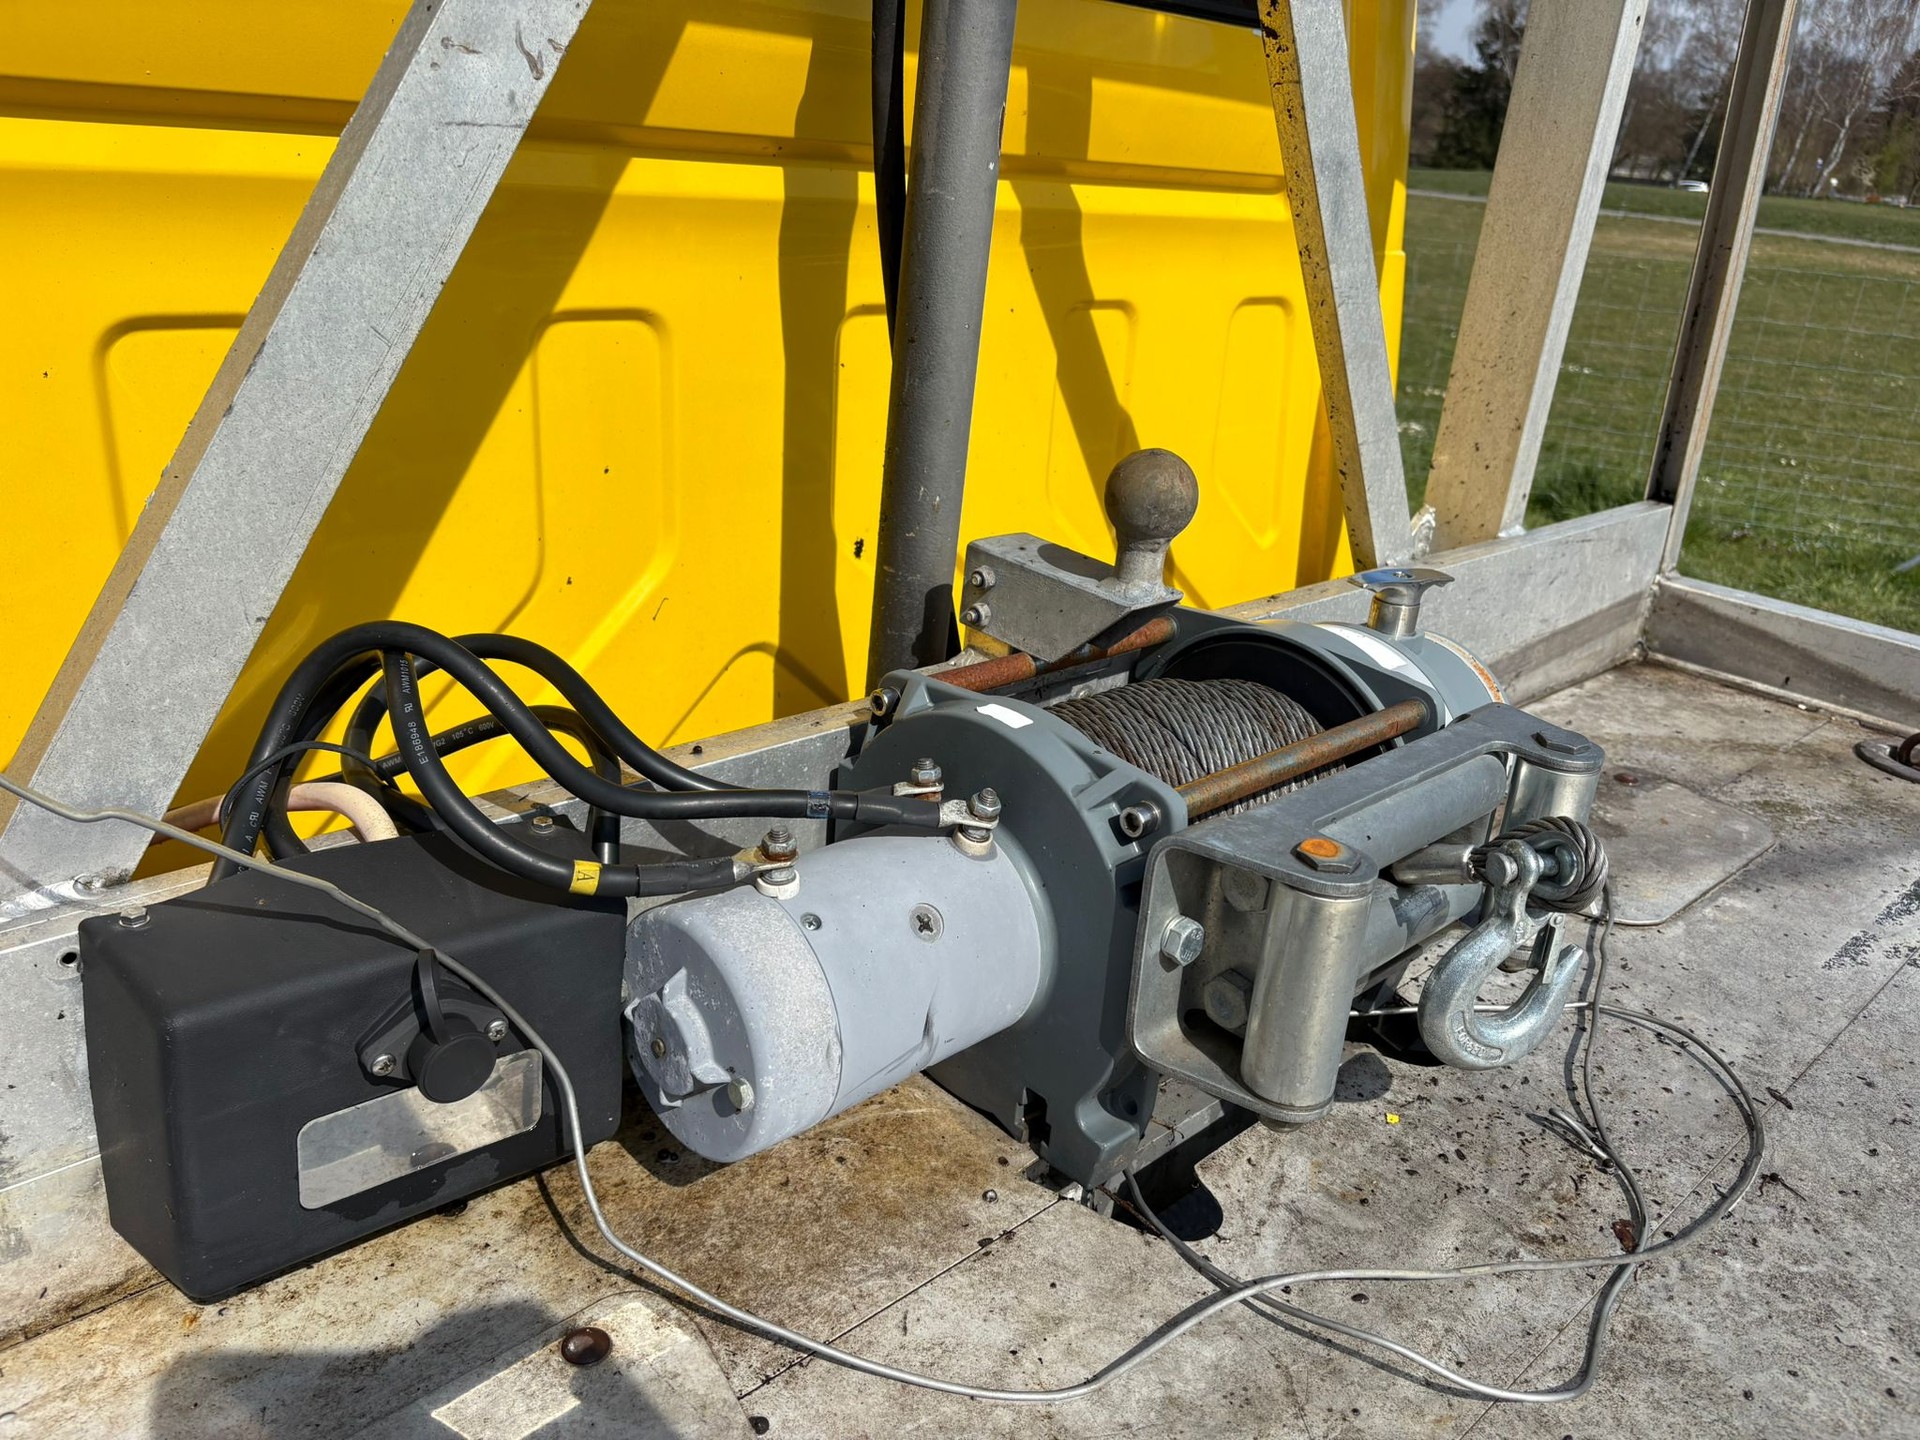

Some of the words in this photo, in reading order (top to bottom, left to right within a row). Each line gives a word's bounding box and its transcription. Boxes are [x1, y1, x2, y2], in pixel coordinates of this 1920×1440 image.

[400, 659, 410, 694] AWM1015
[407, 721, 429, 765] E186948
[255, 781, 269, 804] AWM
[577, 869, 596, 881] A
